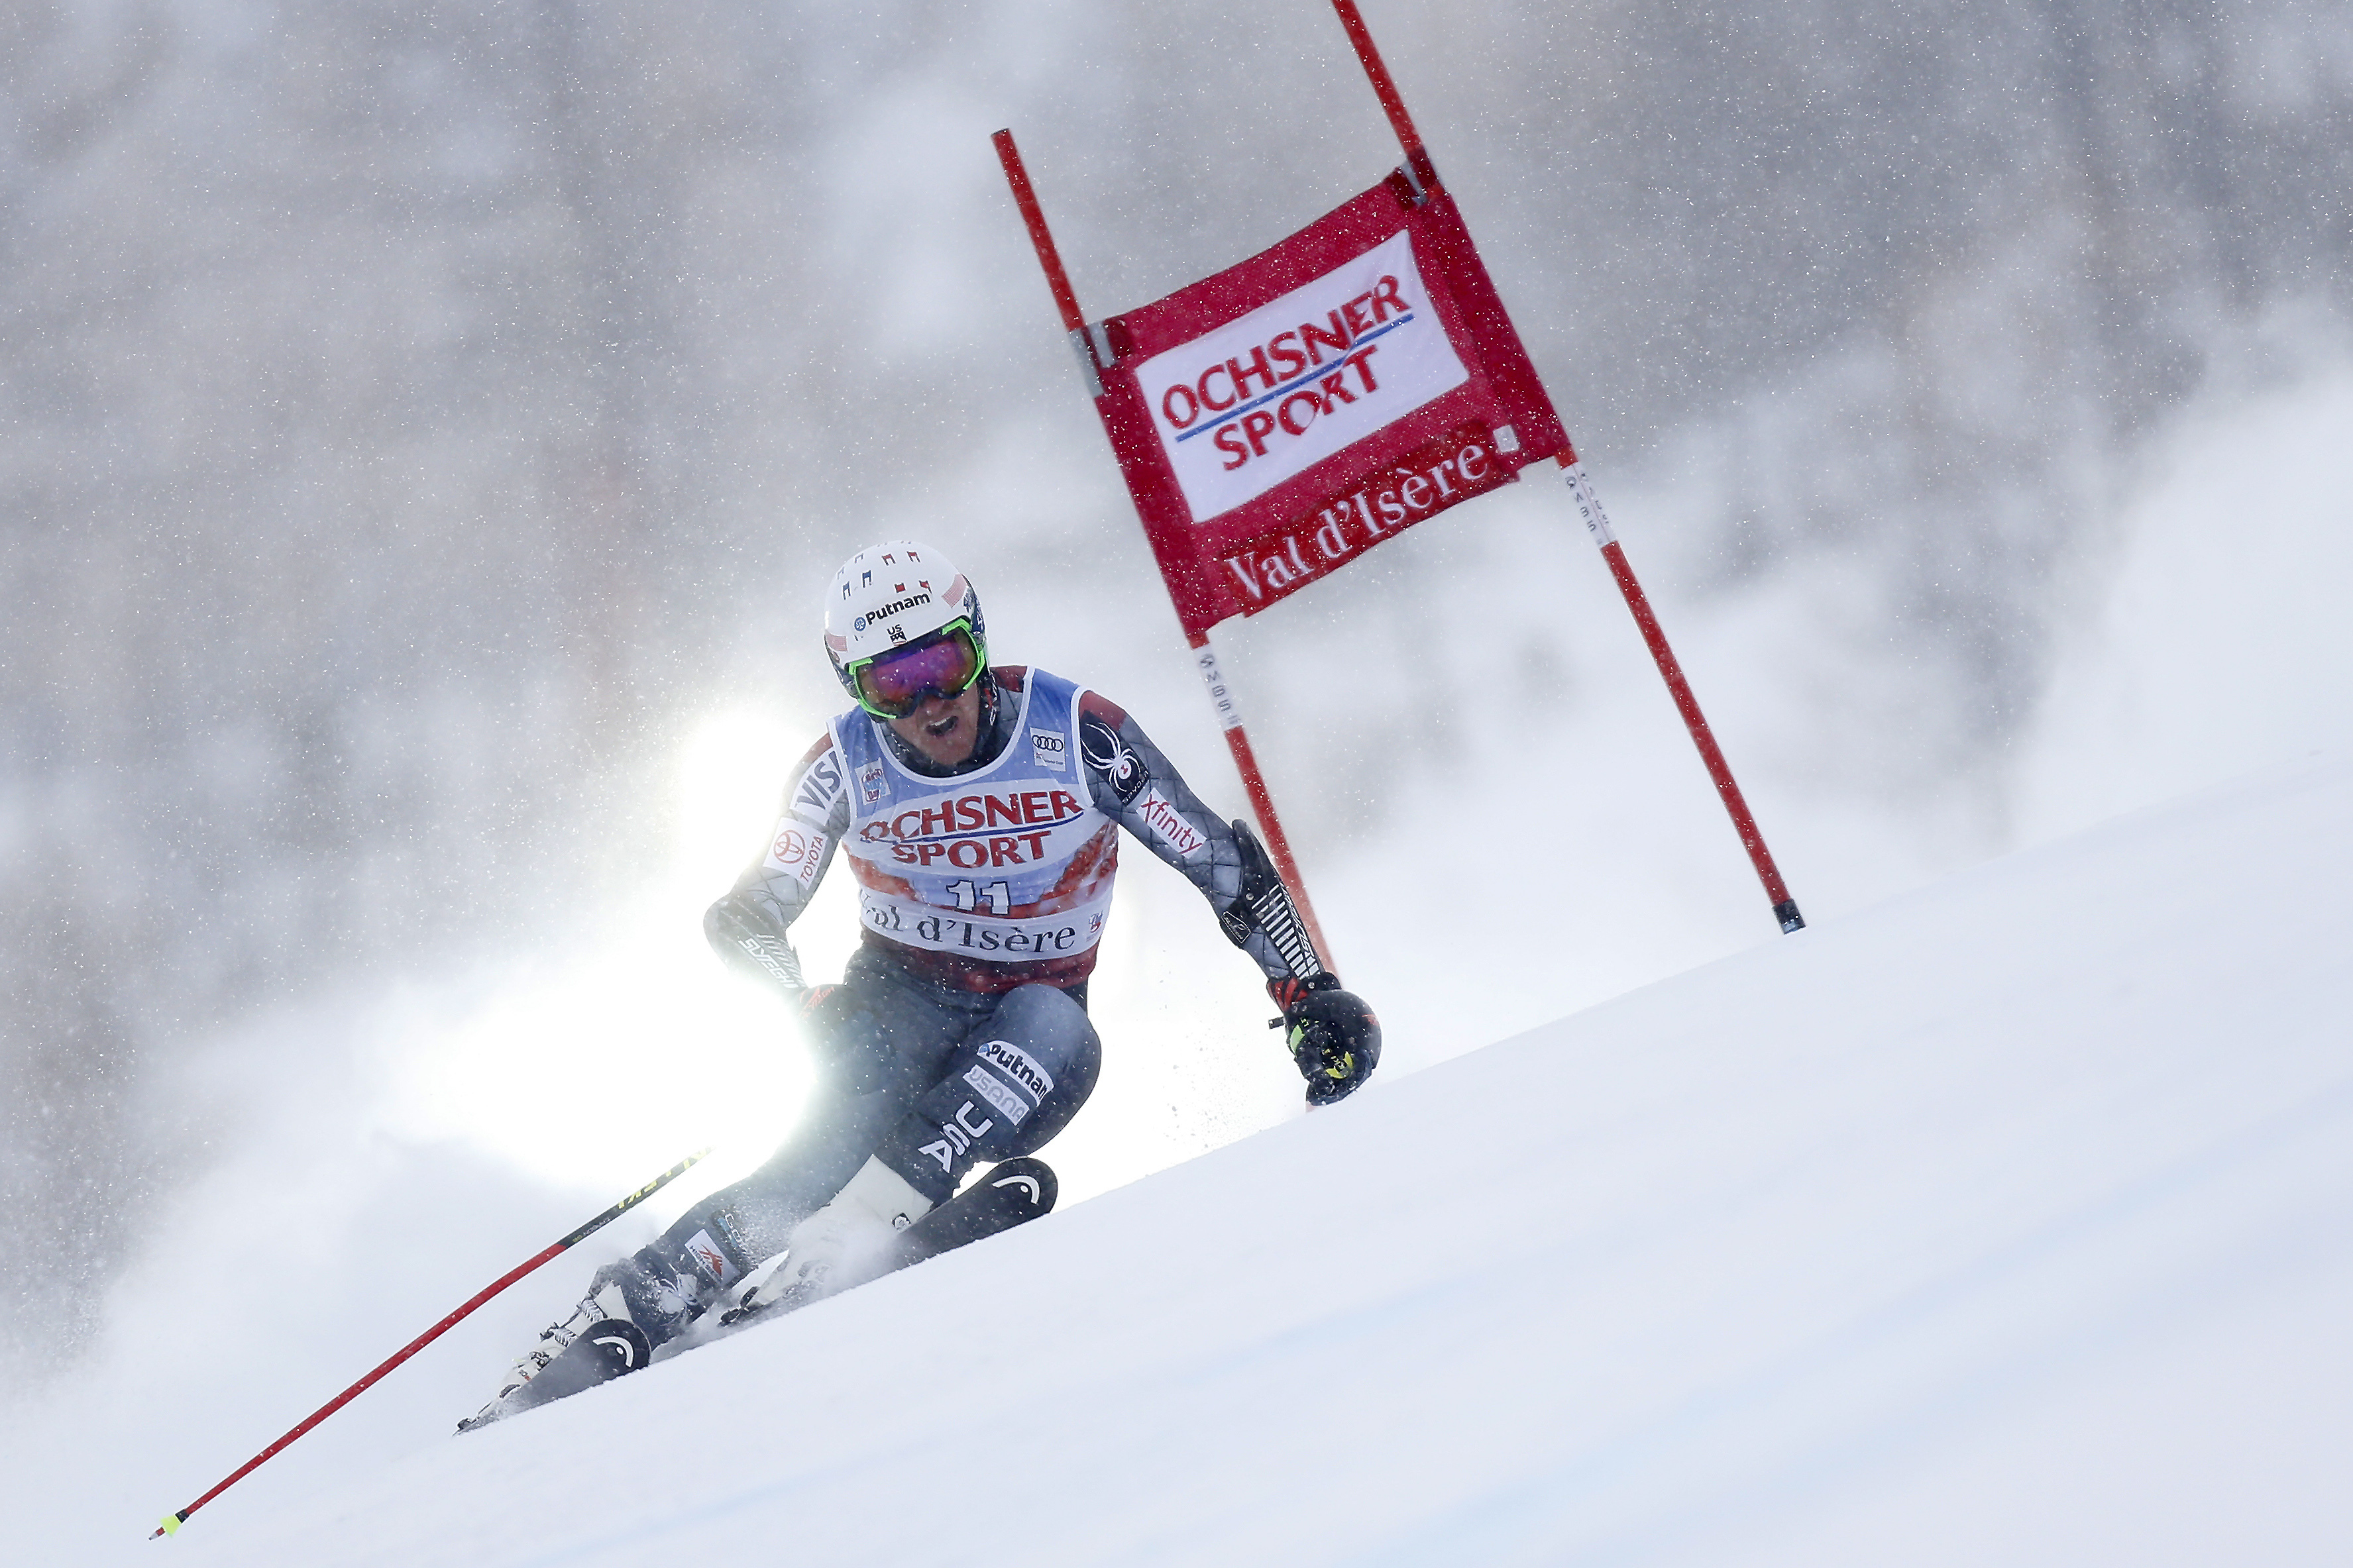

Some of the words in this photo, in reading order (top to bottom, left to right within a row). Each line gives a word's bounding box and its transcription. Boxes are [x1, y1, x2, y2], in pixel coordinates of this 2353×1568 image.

[1162, 274, 1413, 429] OCHSNER
[1213, 344, 1379, 471] SPORT
[1227, 537, 1315, 601] Val
[1319, 443, 1490, 560] d'Isère
[865, 593, 931, 625] Putnam
[860, 790, 1085, 841] OCHSNER
[1140, 793, 1203, 855] xfinity
[800, 835, 824, 884] TOYOTA
[892, 831, 1052, 868] SPORT
[946, 879, 1012, 915] 11
[916, 915, 1076, 953] d'Isère
[969, 1069, 1026, 1119] USANA
